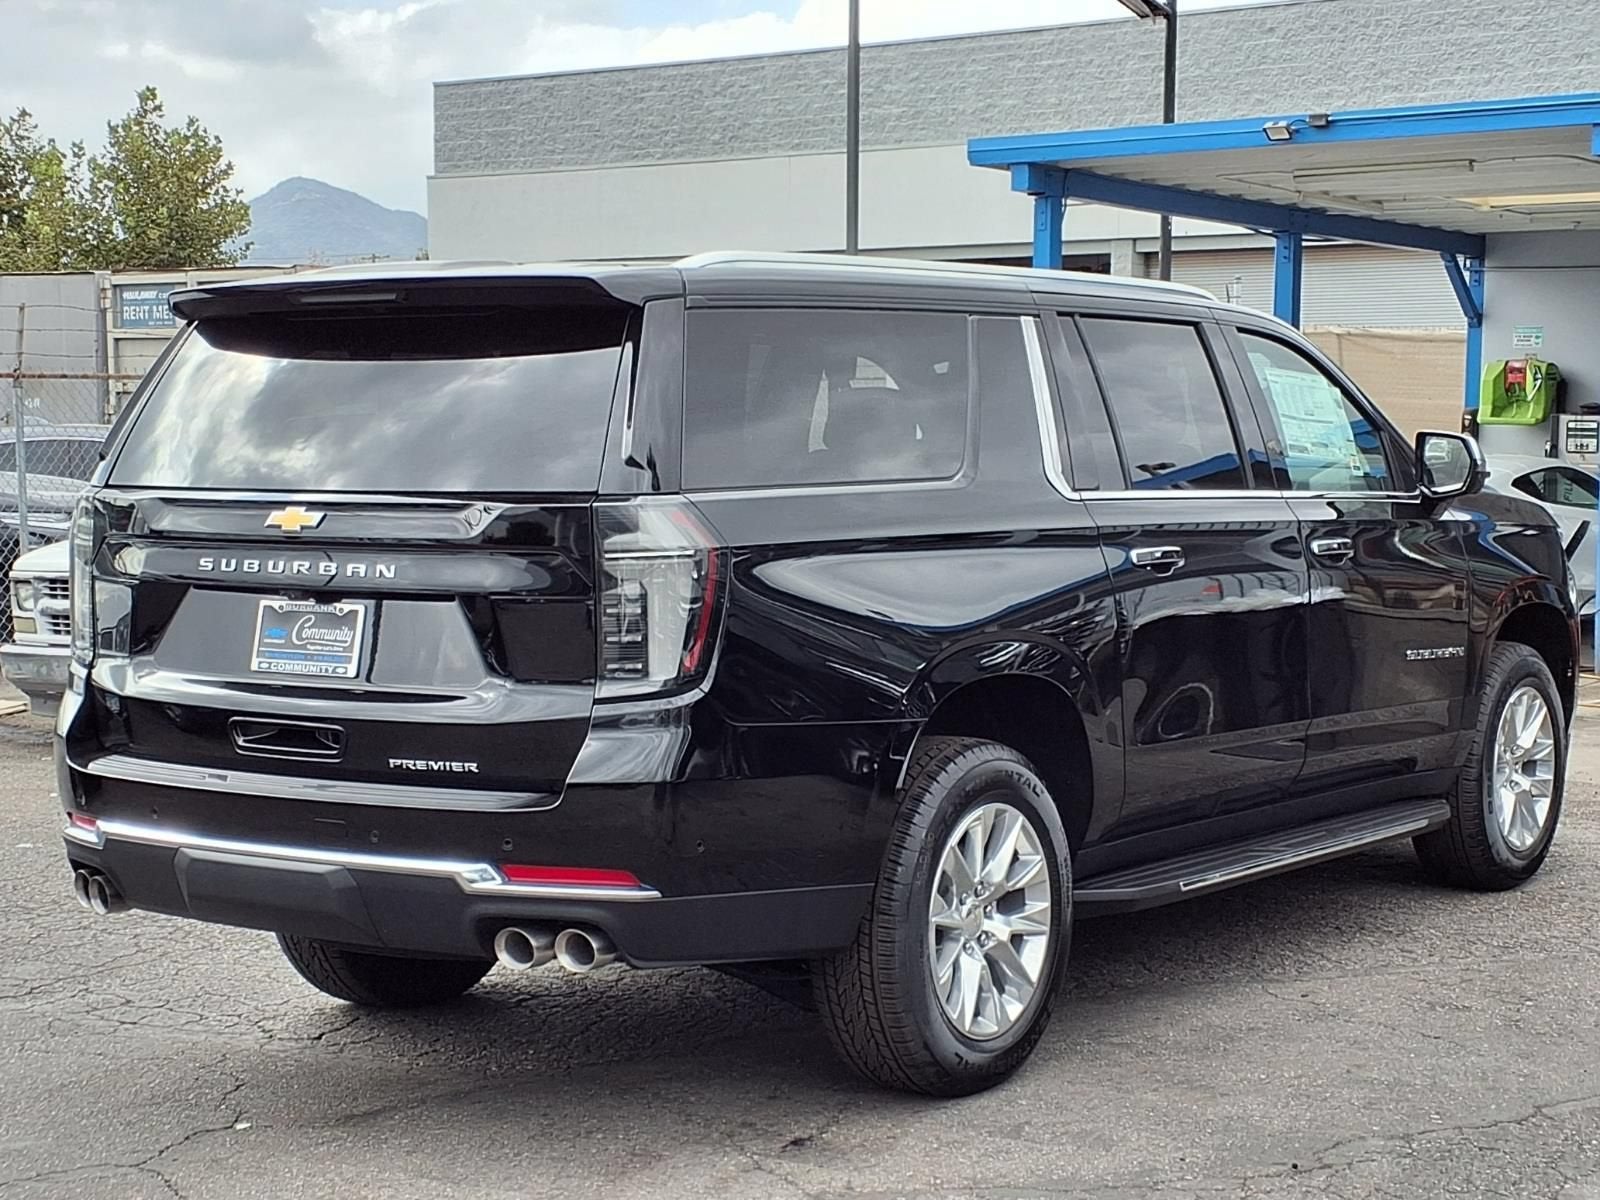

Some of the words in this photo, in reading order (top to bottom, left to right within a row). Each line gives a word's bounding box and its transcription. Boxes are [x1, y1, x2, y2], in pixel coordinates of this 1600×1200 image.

[123, 305, 150, 320] RENT
[198, 557, 397, 578] SUBURBAN
[291, 614, 354, 647] Community
[270, 662, 335, 674] COMMUNITY
[388, 758, 480, 773] PREMIER
